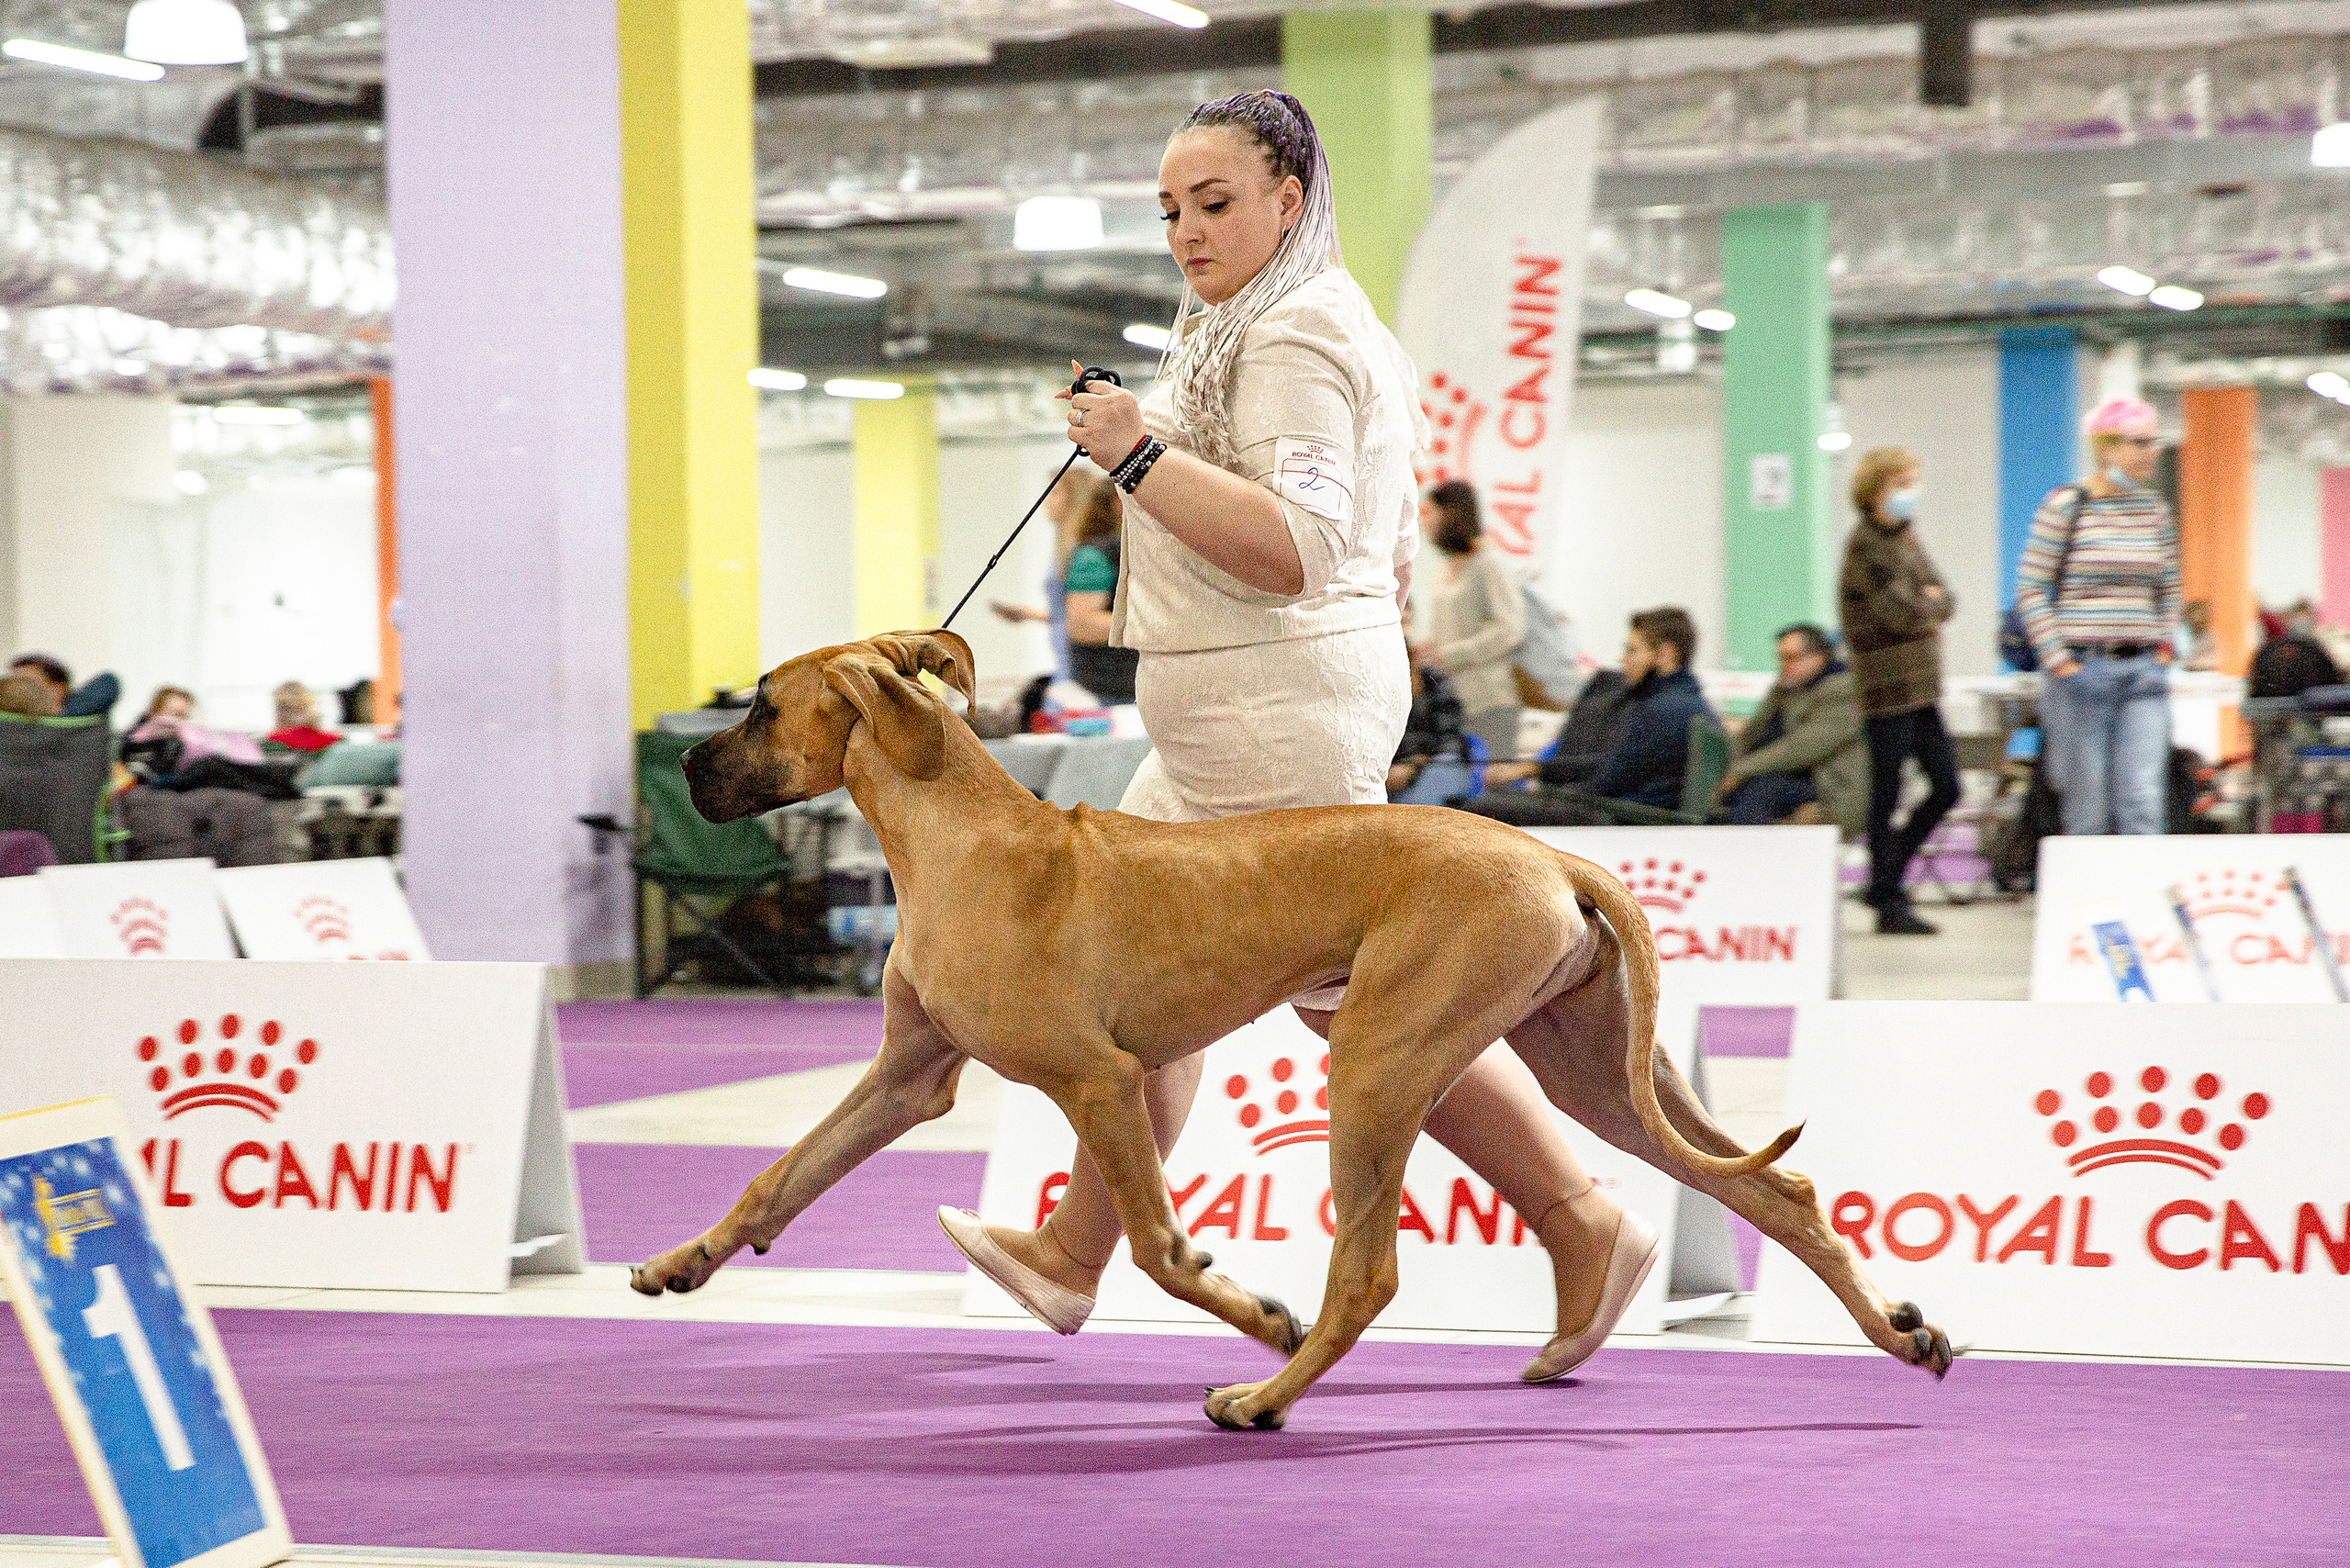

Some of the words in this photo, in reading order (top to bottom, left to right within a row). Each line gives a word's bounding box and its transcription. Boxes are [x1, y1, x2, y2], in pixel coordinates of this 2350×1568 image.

[1498, 252, 1563, 450] CANIN
[1292, 451, 1313, 459] ROYAL
[1298, 466, 1325, 491] 2
[1487, 466, 1543, 556] YAL
[1653, 924, 1798, 962] CANIN
[216, 1138, 459, 1214] CANIN
[1034, 1170, 1290, 1242] RYAL
[1830, 1190, 2114, 1268] ROYAL
[81, 1262, 196, 1472] 1
